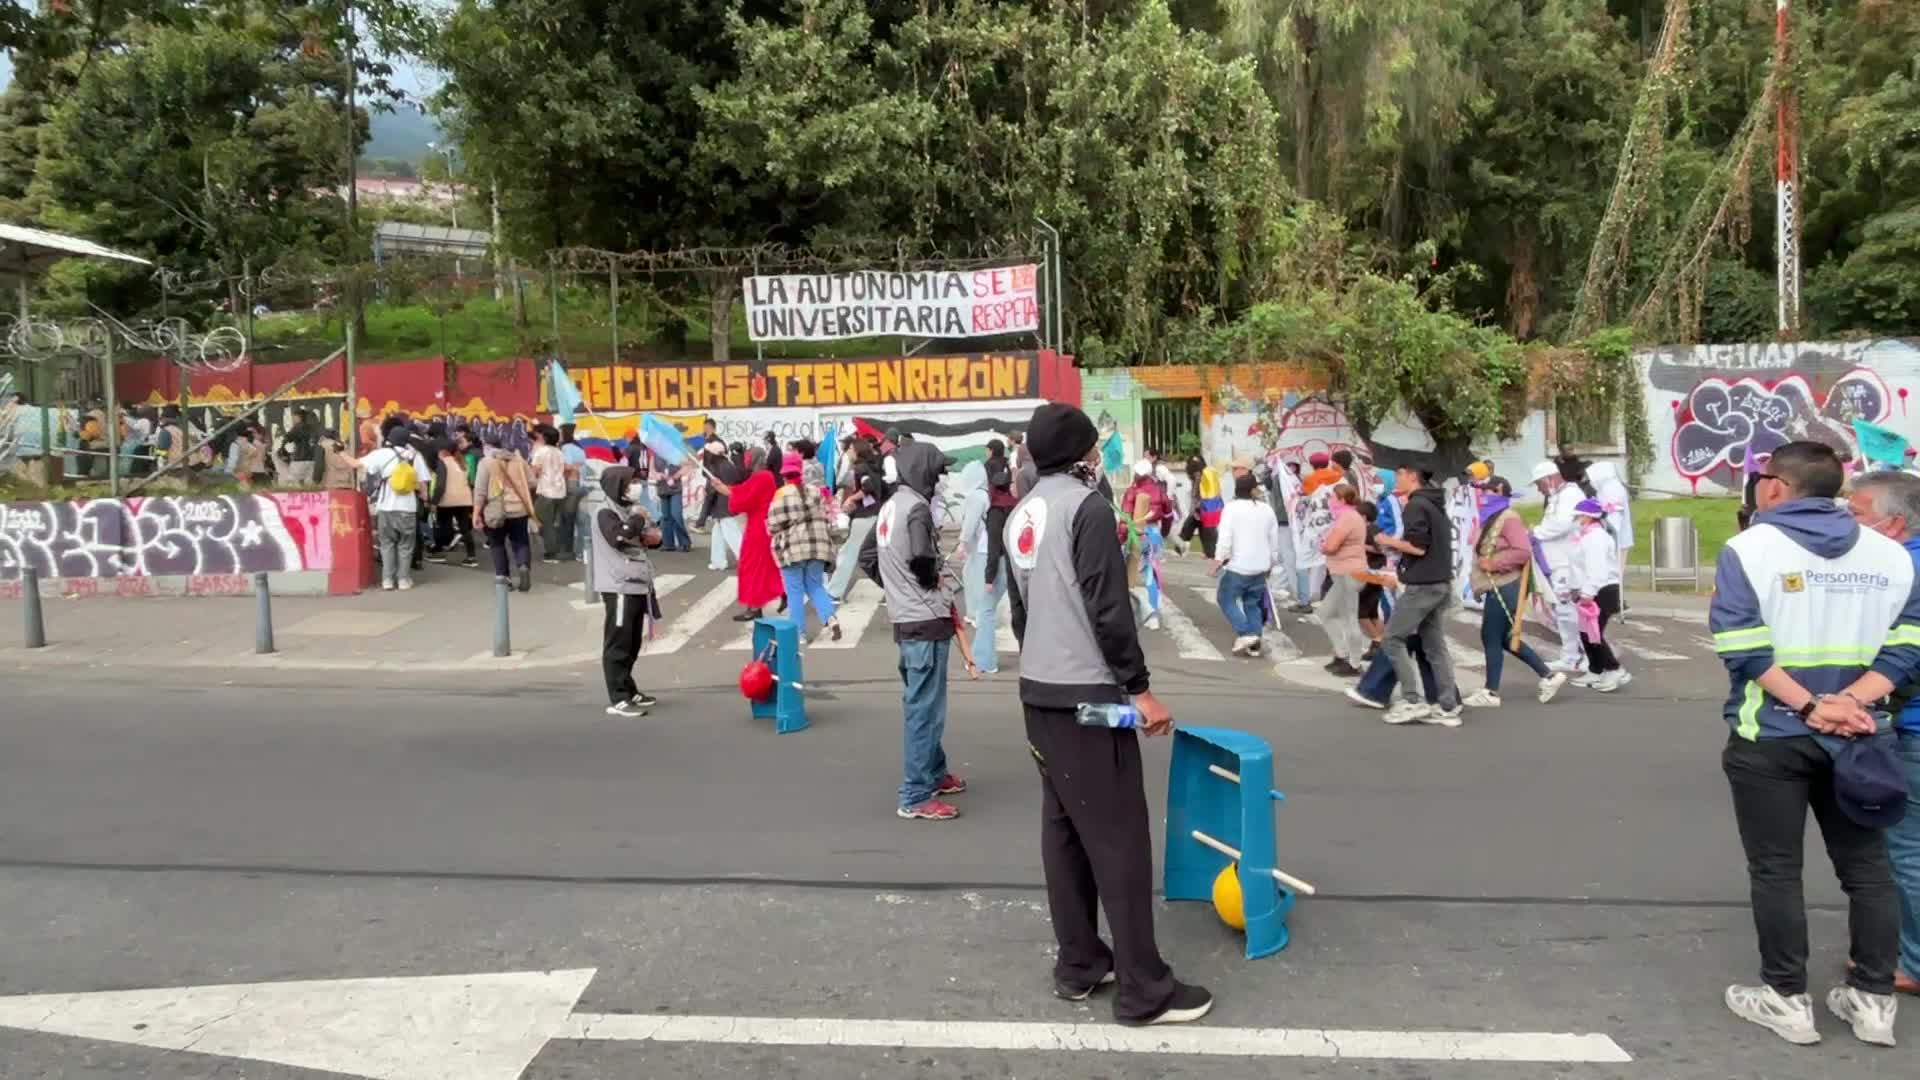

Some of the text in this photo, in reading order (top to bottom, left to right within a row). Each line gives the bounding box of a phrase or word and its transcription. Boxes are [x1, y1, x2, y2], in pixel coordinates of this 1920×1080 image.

[751, 278, 788, 305] LA
[797, 271, 968, 304] AUTONOMIA
[973, 271, 1006, 297] SE
[752, 297, 1039, 338] UNIVERSITARIA RESPETA
